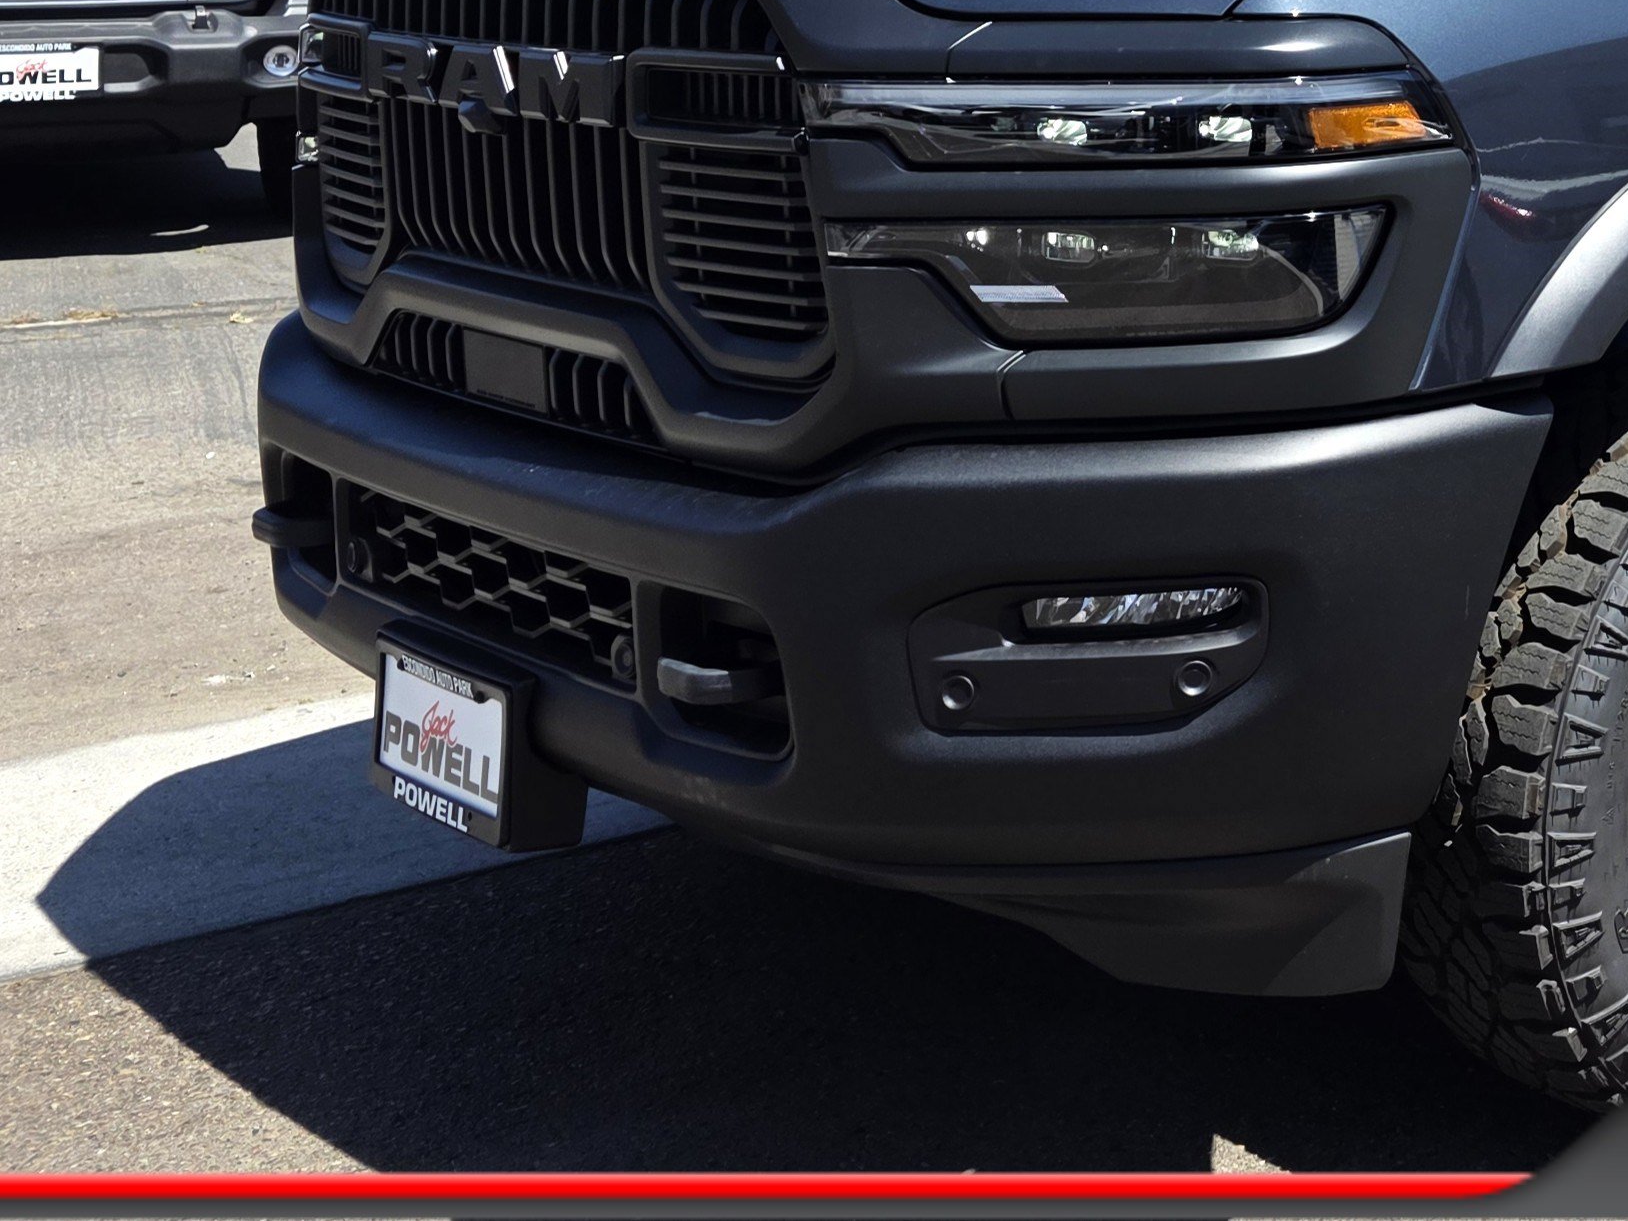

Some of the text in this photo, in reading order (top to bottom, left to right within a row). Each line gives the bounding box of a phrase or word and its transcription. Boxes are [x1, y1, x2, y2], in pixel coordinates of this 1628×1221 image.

[36, 43, 53, 51] AUTO
[54, 42, 72, 50] PARK
[0, 68, 92, 85] OWELL
[366, 31, 626, 129] RAM
[402, 655, 475, 699] ESCONDIDO AUTO PARK
[420, 699, 458, 753] Jack
[383, 710, 499, 803] POWELL
[394, 775, 469, 833] POWELL
